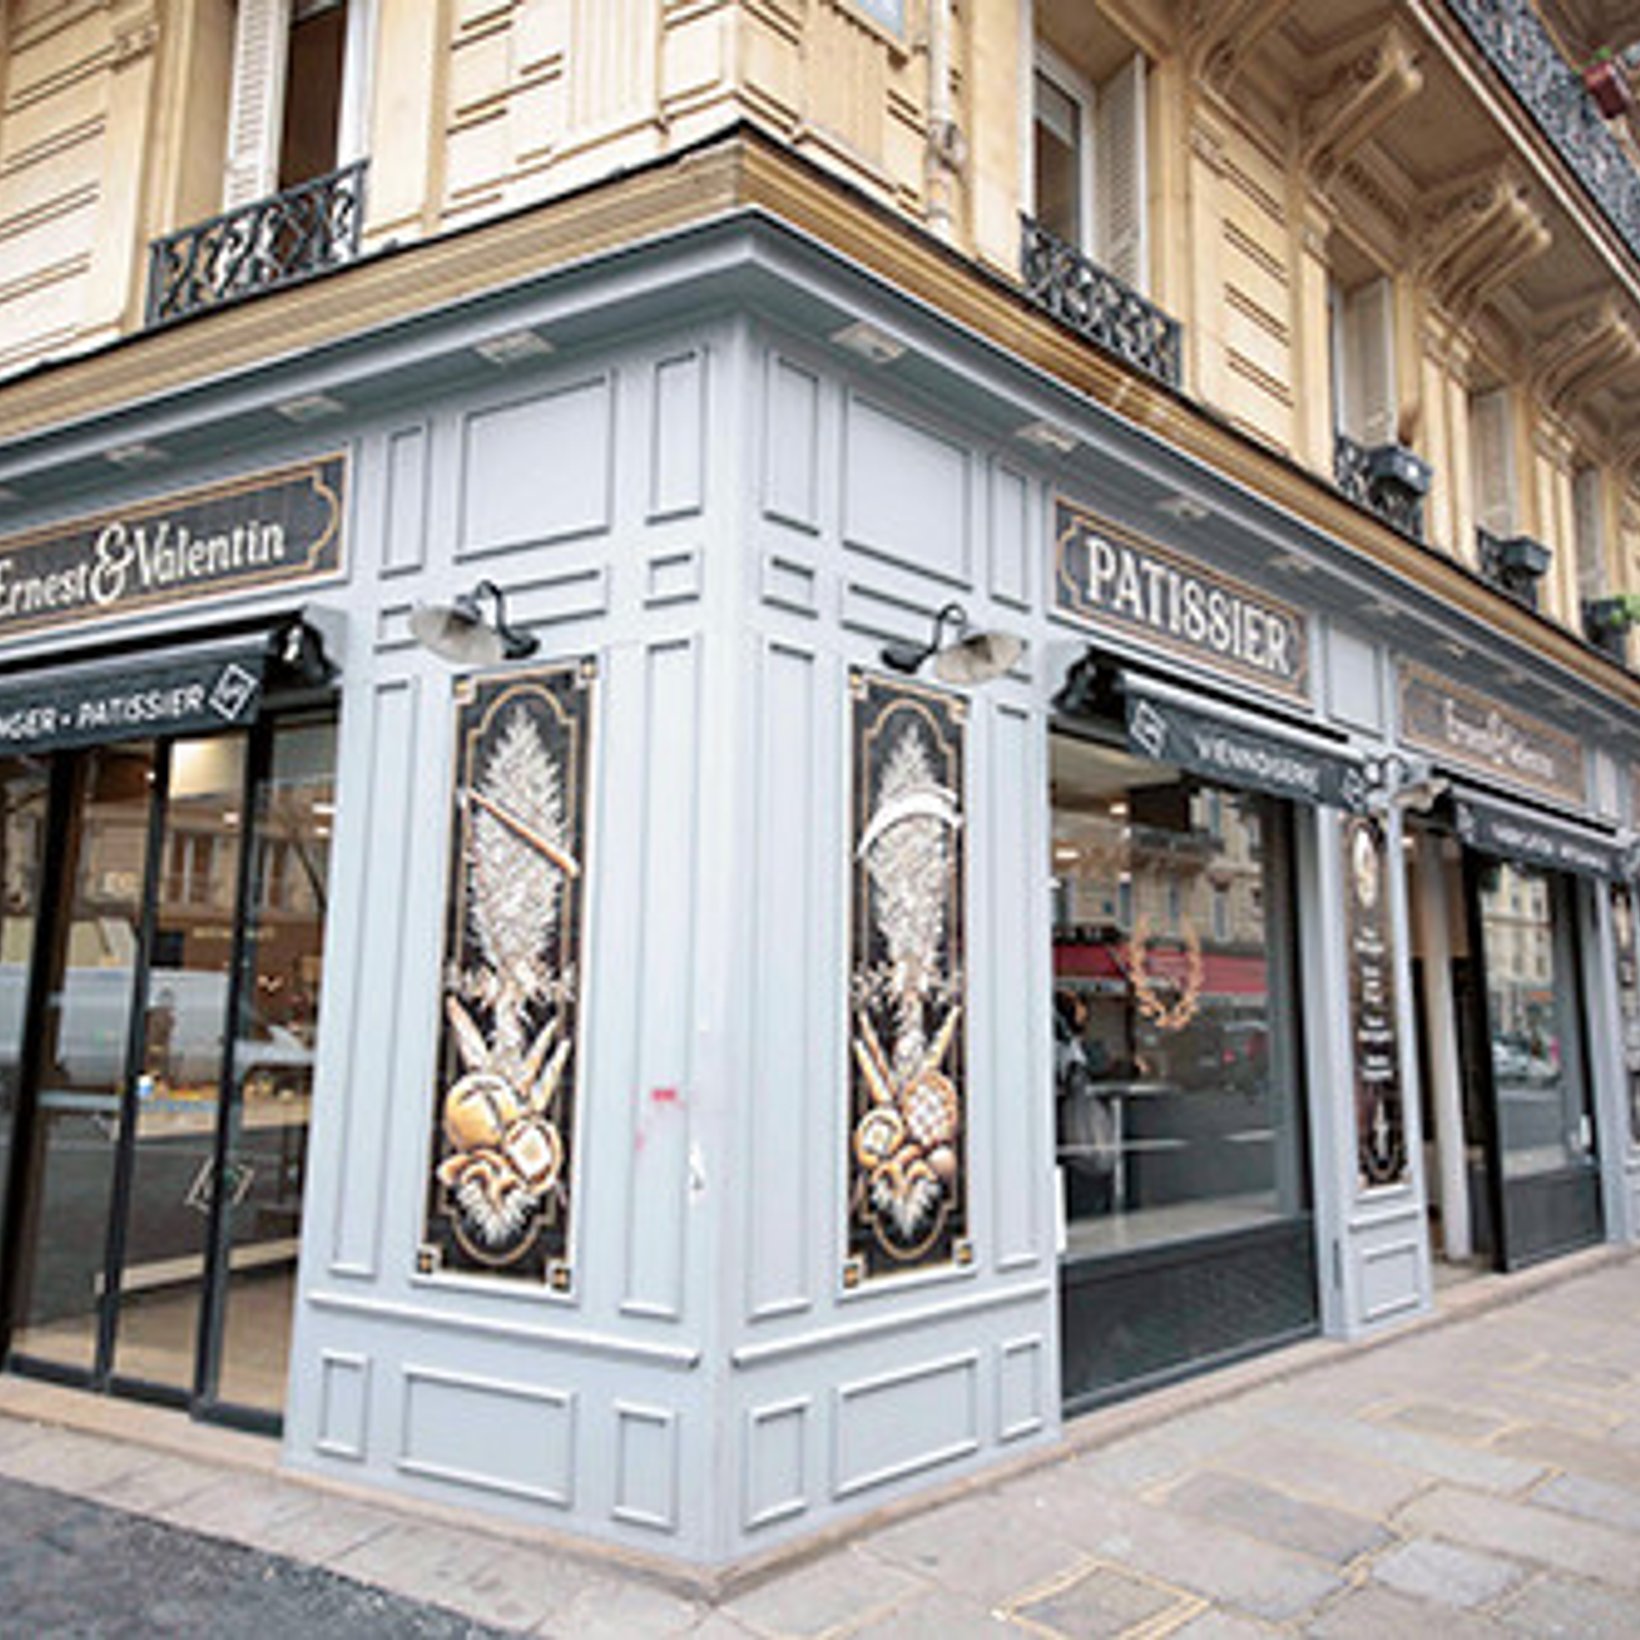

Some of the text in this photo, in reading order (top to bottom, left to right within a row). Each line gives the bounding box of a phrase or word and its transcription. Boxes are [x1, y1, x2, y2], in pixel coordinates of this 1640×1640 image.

[90, 523, 134, 605] &
[135, 519, 285, 586] Valentin
[1086, 536, 1289, 675] PATISSIER
[76, 684, 206, 729] PATISSIER
